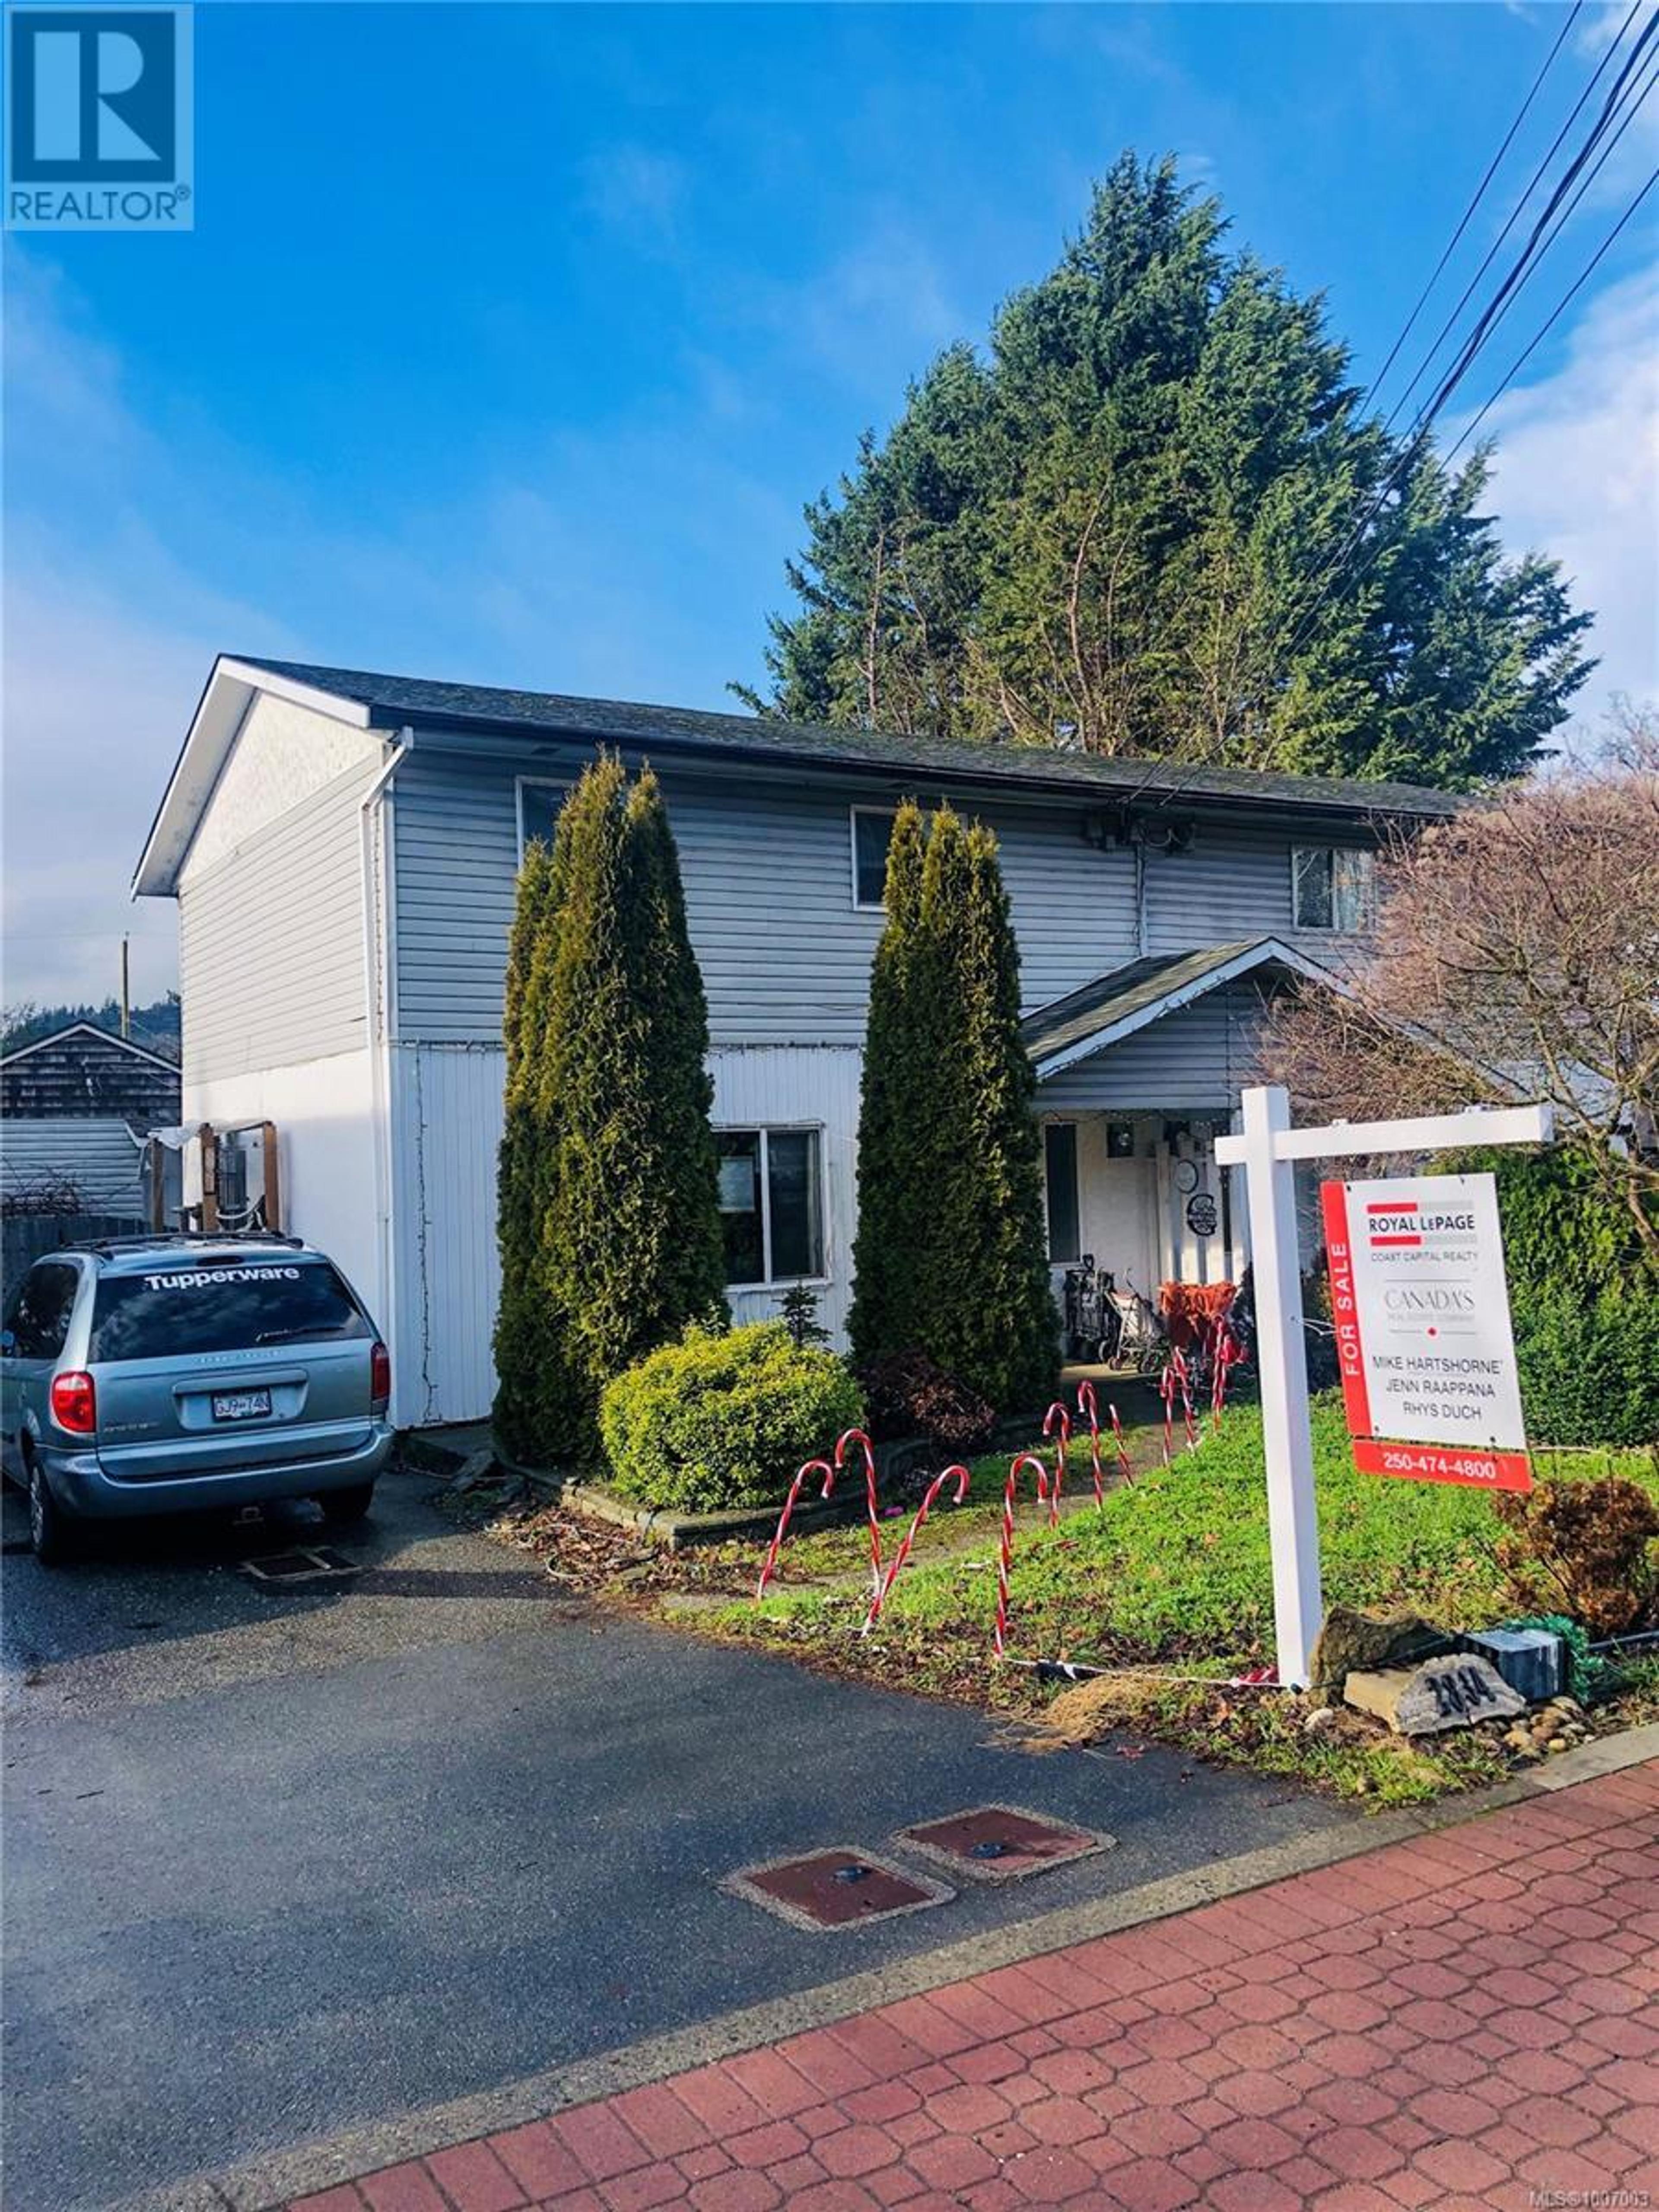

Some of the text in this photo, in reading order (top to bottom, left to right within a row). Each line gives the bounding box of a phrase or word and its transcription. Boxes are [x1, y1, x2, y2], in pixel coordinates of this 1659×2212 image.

[1369, 1217, 1417, 1232] ROYAL
[1371, 1251, 1478, 1262] COAST CAPITAL REALTY
[144, 1267, 300, 1290] Tupperware
[1331, 1243, 1360, 1376] FOR SALE
[1372, 1356, 1403, 1370] MIKE
[1386, 1379, 1496, 1398] JENN RAAPPANA
[1403, 1401, 1482, 1420] RHYS DUCH
[1383, 1452, 1496, 1479] 250-474-4800
